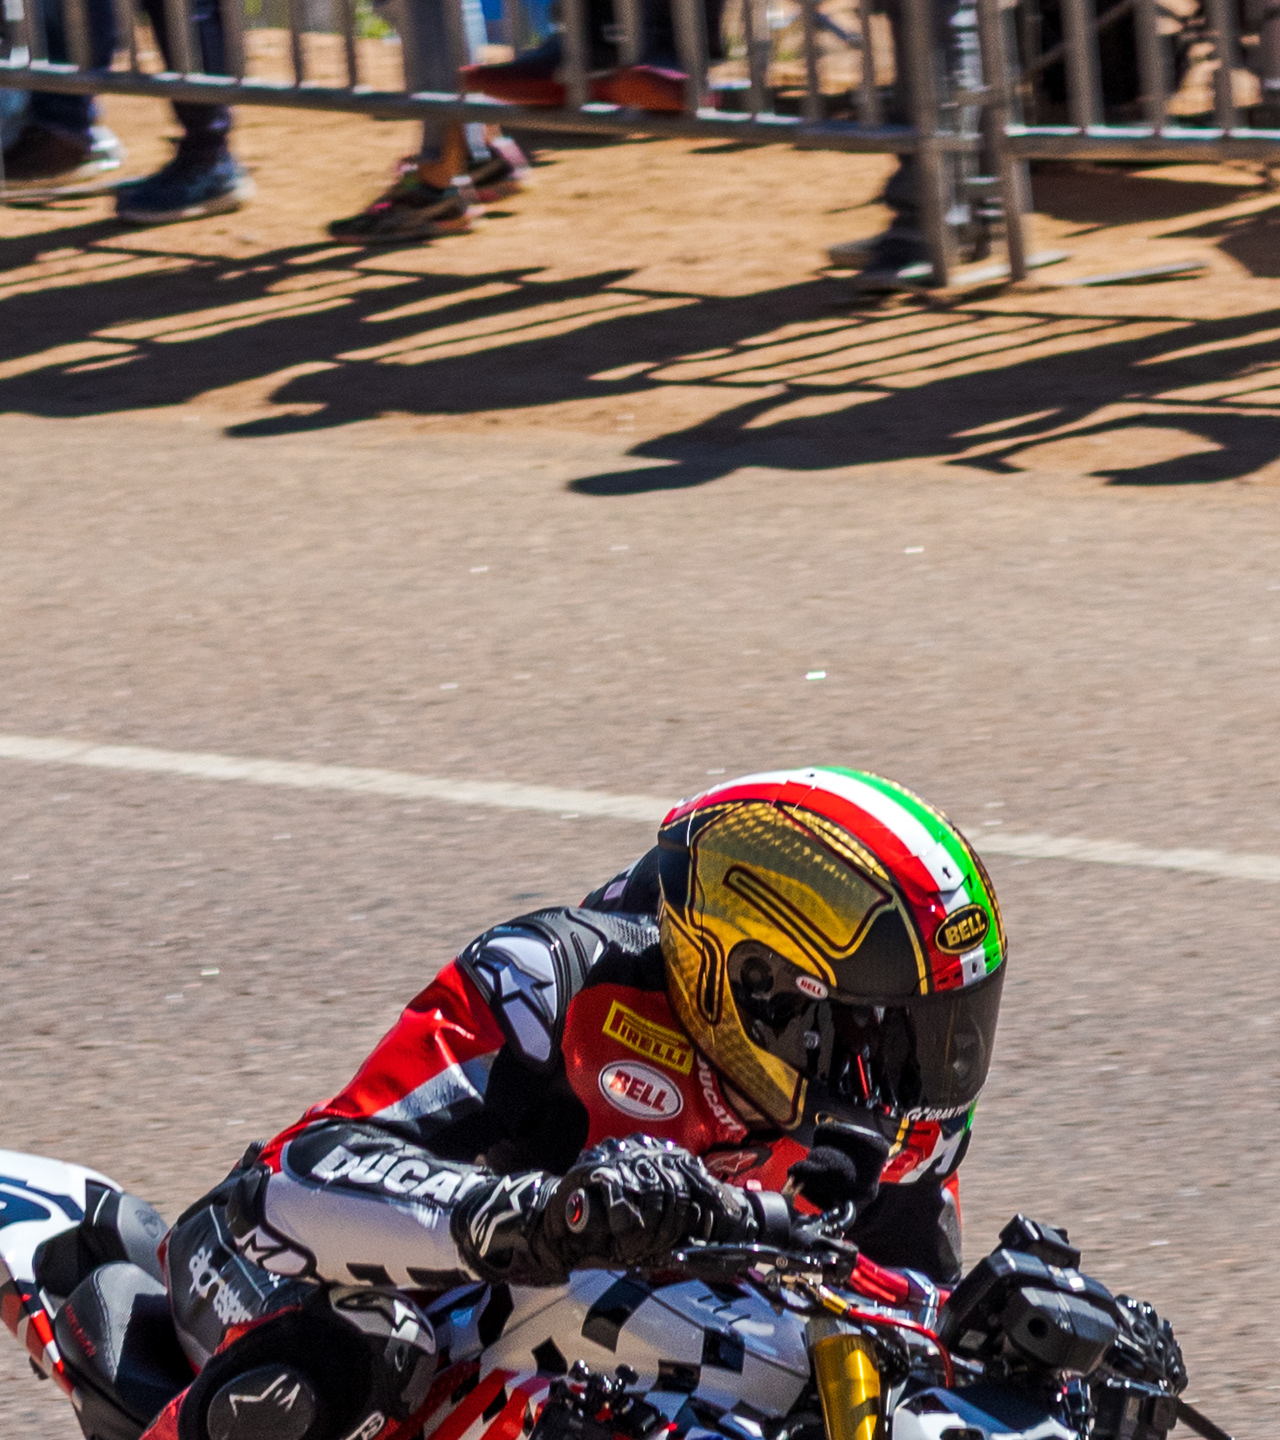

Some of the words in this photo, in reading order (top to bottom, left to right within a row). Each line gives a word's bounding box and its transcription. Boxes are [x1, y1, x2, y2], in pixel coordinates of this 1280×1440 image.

[944, 912, 986, 948] BELL
[800, 978, 823, 997] BELL
[608, 1008, 691, 1068] PIRELLI
[608, 1068, 668, 1114] BELL
[311, 1144, 487, 1204] DUCAT
